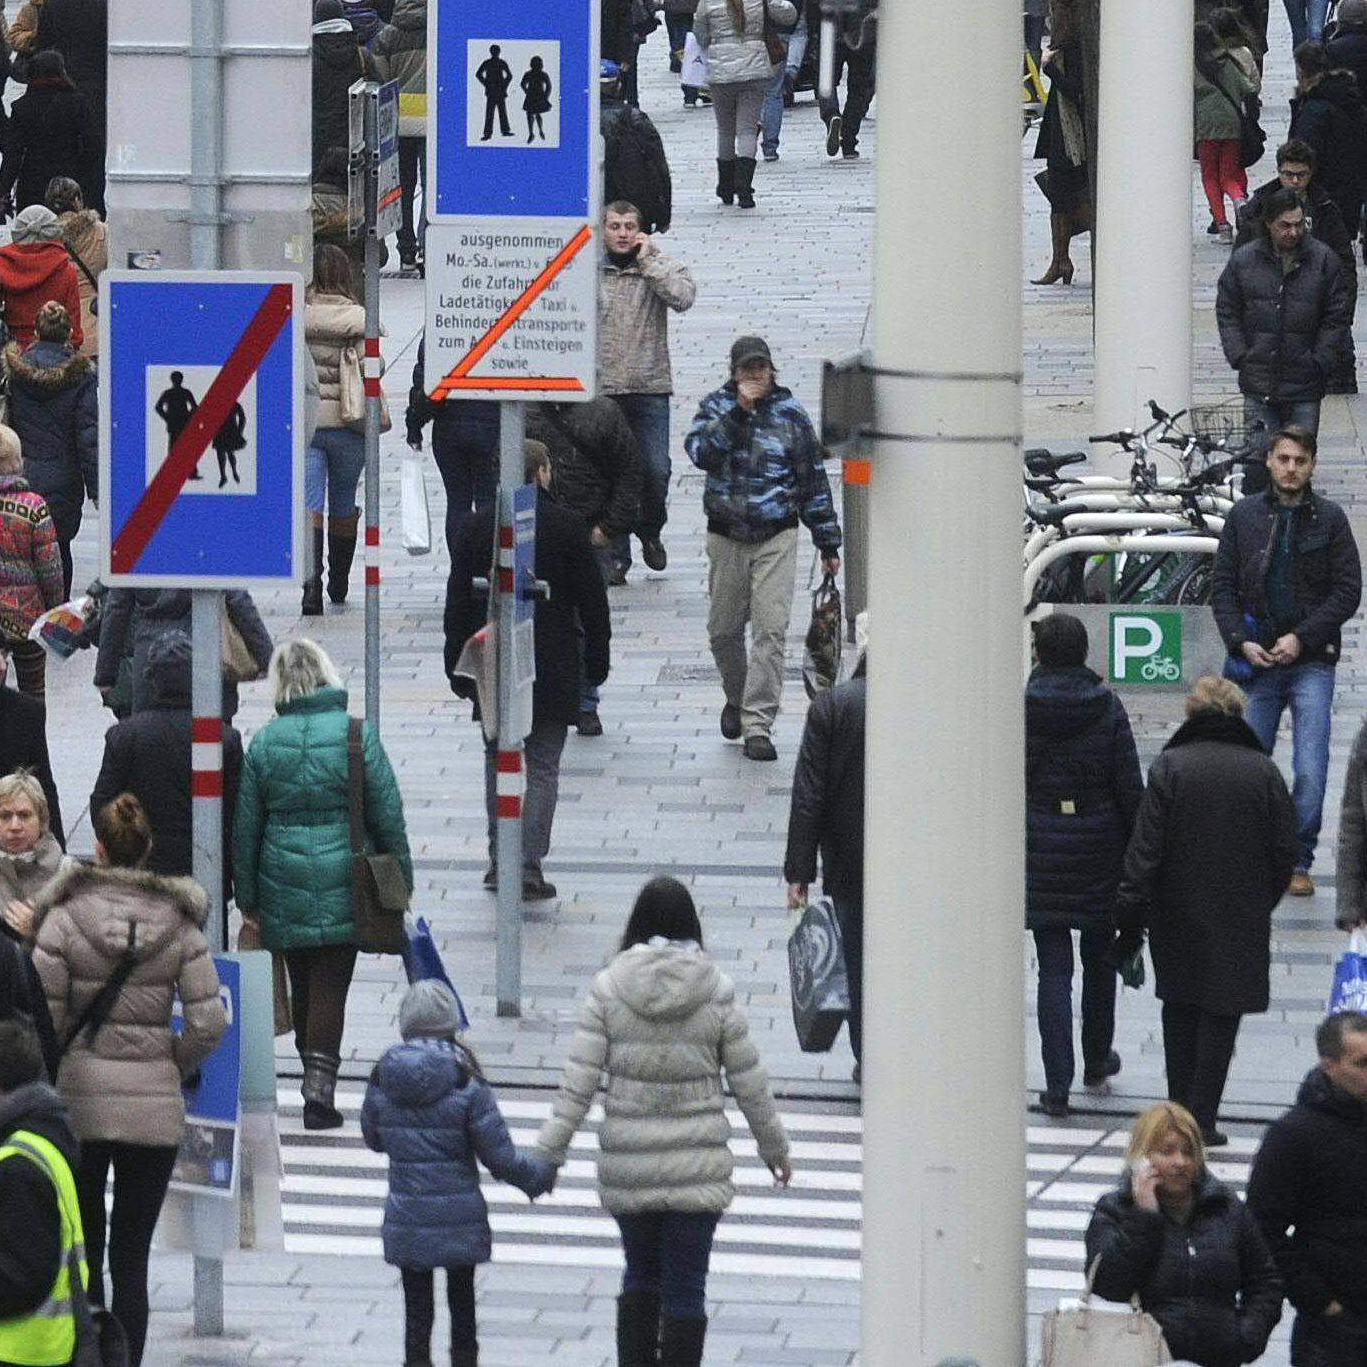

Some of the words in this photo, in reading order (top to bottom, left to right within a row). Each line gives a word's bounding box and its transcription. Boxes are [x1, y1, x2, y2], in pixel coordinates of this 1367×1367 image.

[460, 234, 564, 249] ausgenommen
[461, 275, 483, 289] die
[439, 294, 532, 313] Ladetätigk,
[541, 297, 567, 311] Taxi
[435, 314, 586, 332] Behindetransporte
[438, 336, 465, 349] zum
[514, 337, 583, 353] Einsteigen
[491, 356, 529, 370] sowie
[1114, 616, 1164, 680] P
